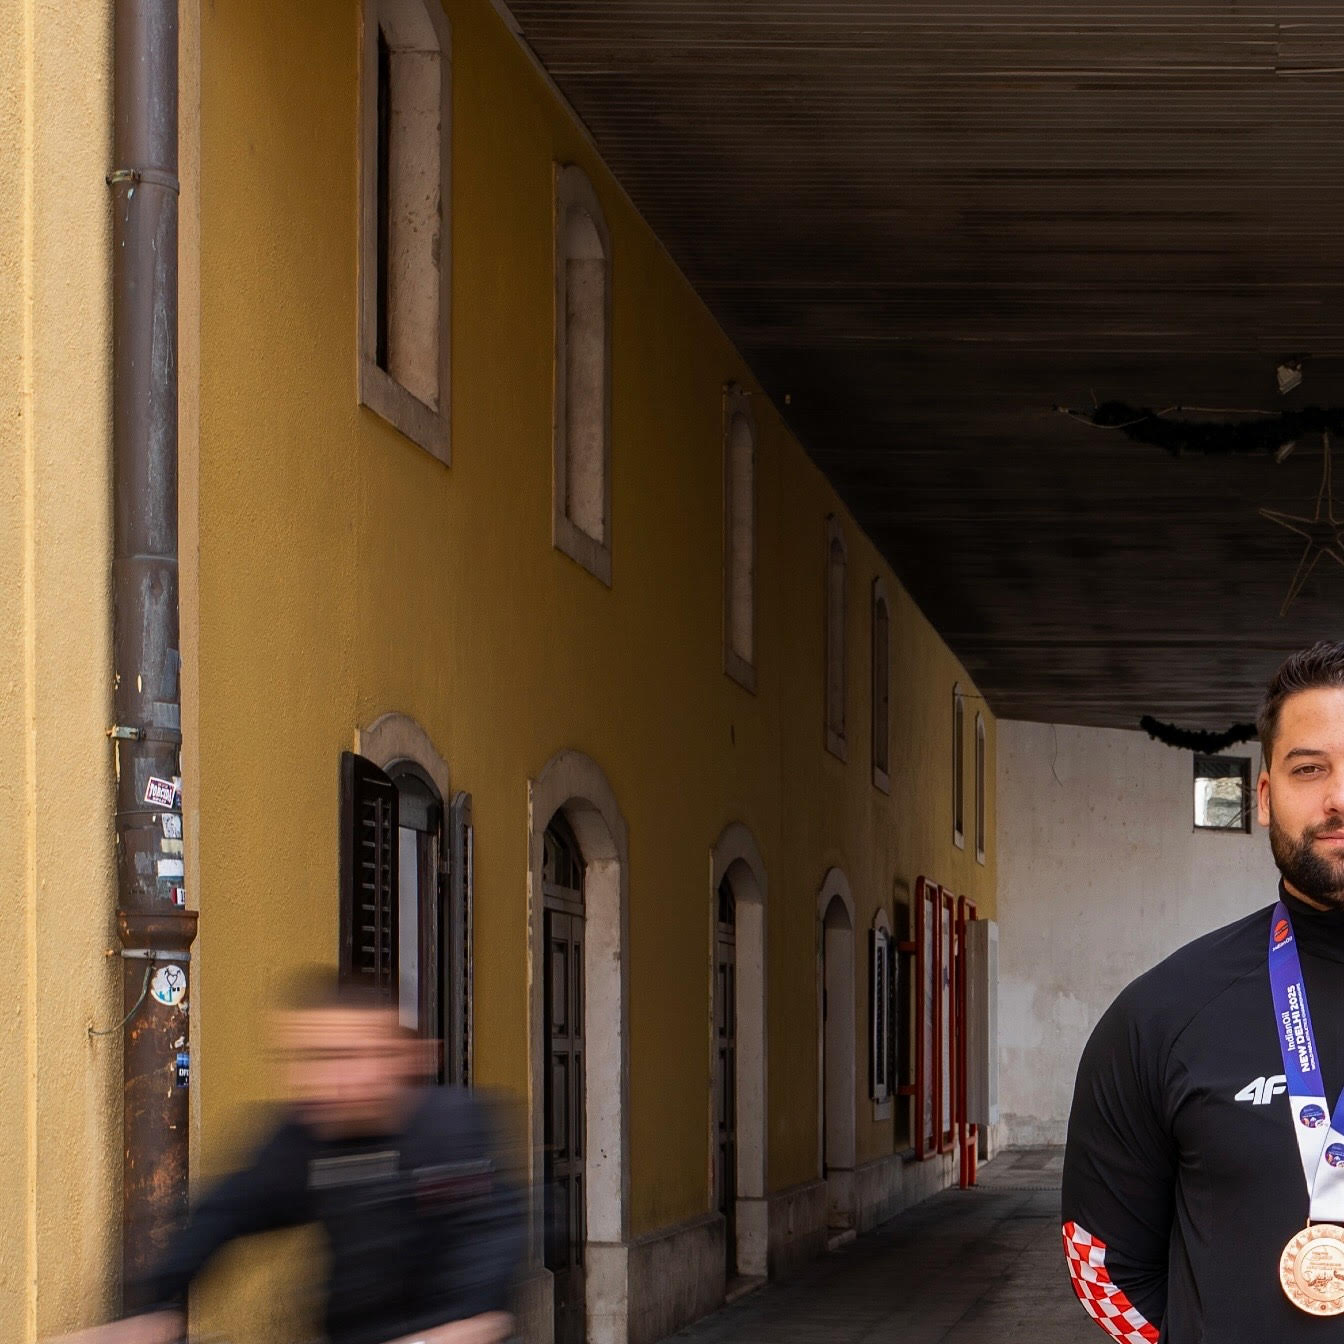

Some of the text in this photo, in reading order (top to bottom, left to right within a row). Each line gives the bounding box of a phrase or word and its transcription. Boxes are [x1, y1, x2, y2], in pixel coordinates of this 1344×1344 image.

[1281, 1011, 1296, 1051] IndianOil
[1287, 985, 1311, 1073] NEW DELHI 2025
[1234, 1074, 1288, 1105] 4F
